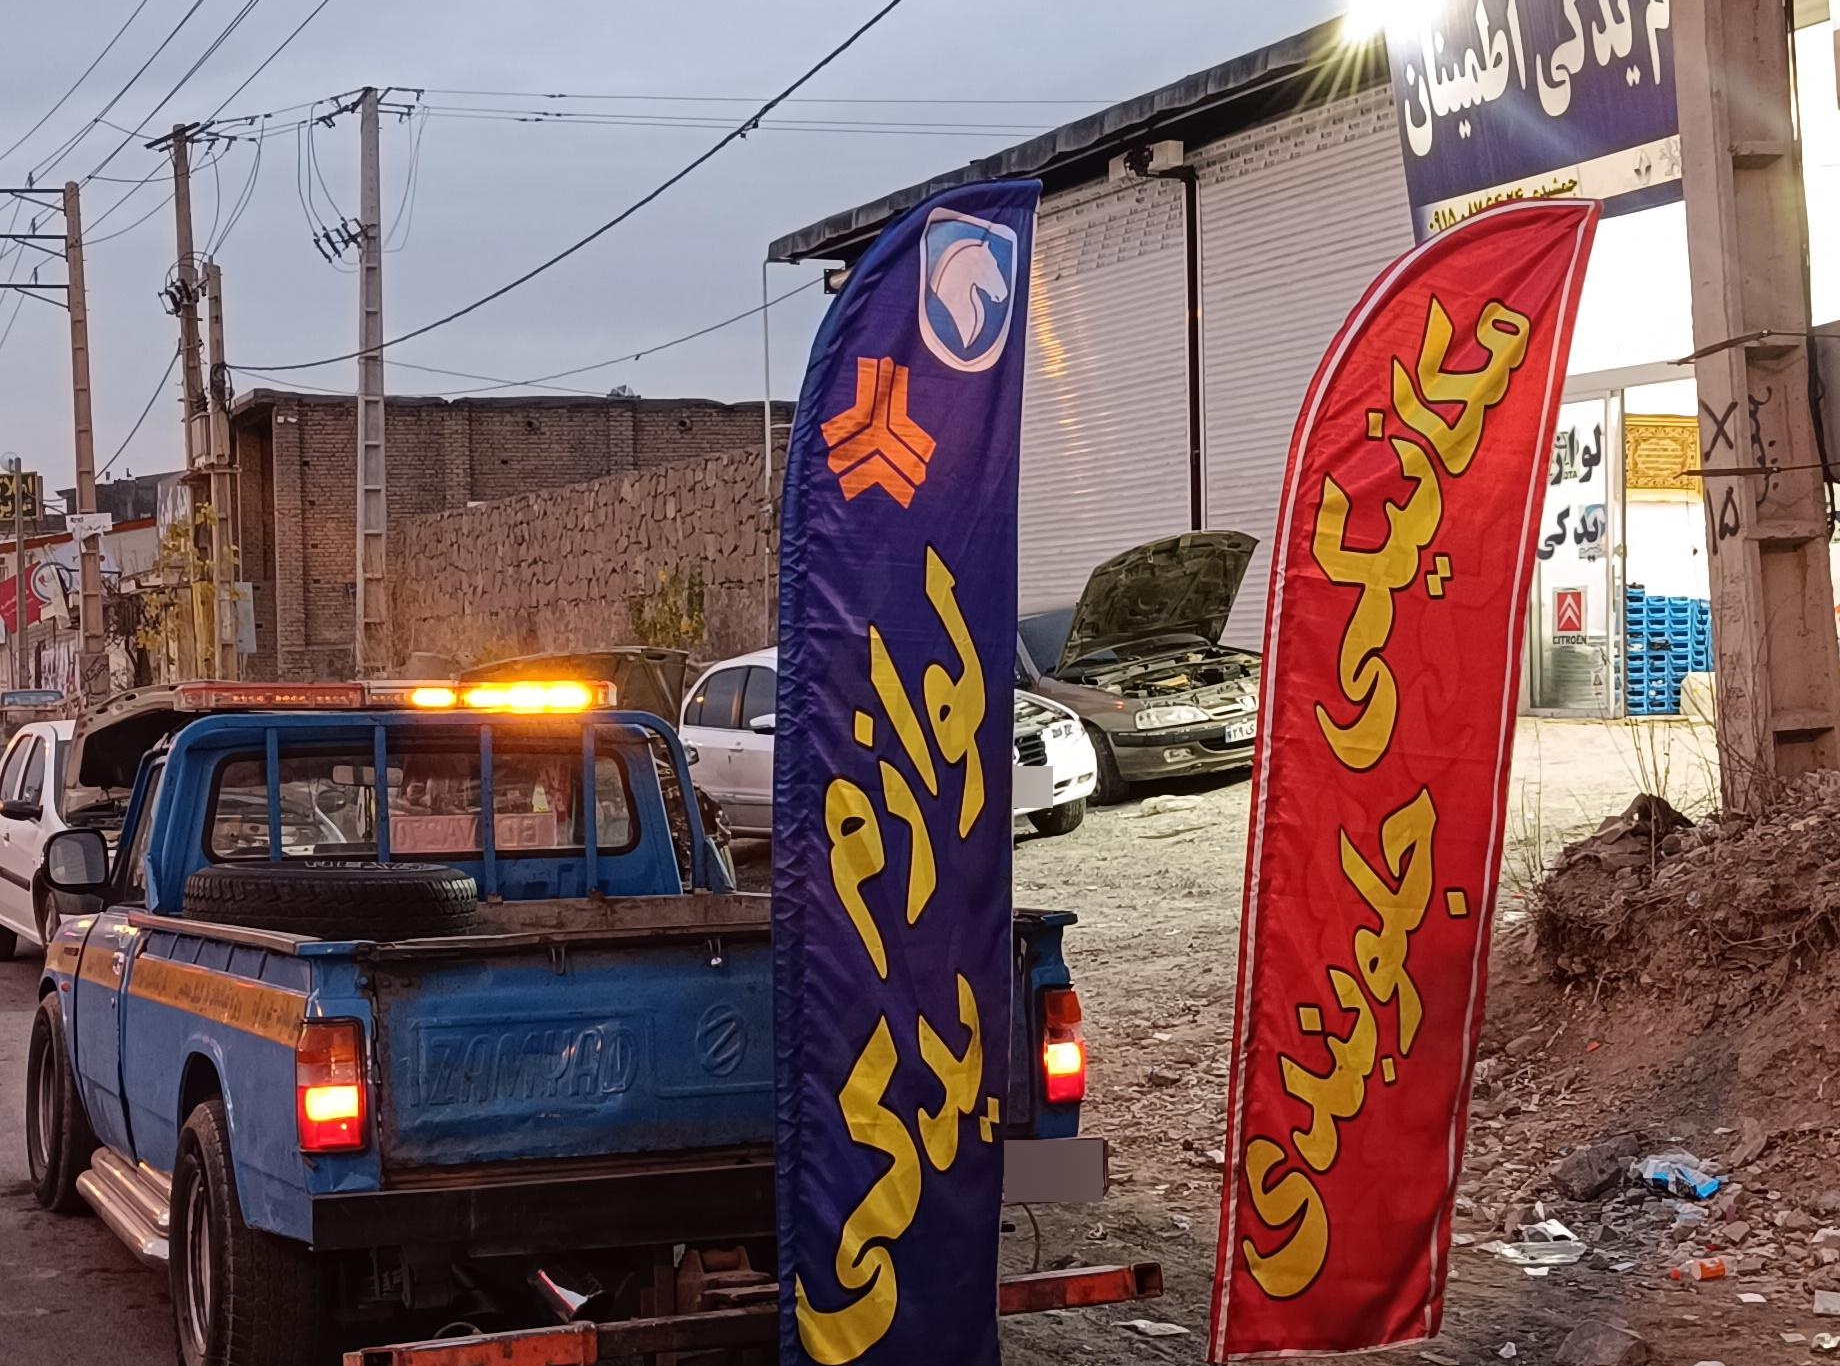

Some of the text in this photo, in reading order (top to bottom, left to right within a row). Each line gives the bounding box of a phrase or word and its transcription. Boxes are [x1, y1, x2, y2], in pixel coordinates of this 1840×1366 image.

[1312, 294, 1532, 772] مکانیکی
[1537, 504, 1599, 563] یدکی
[1549, 422, 1602, 485] لواز
[822, 543, 988, 981] لوازم
[428, 1025, 639, 1098] ZAMYAD
[1241, 785, 1468, 1300] جلوبندی
